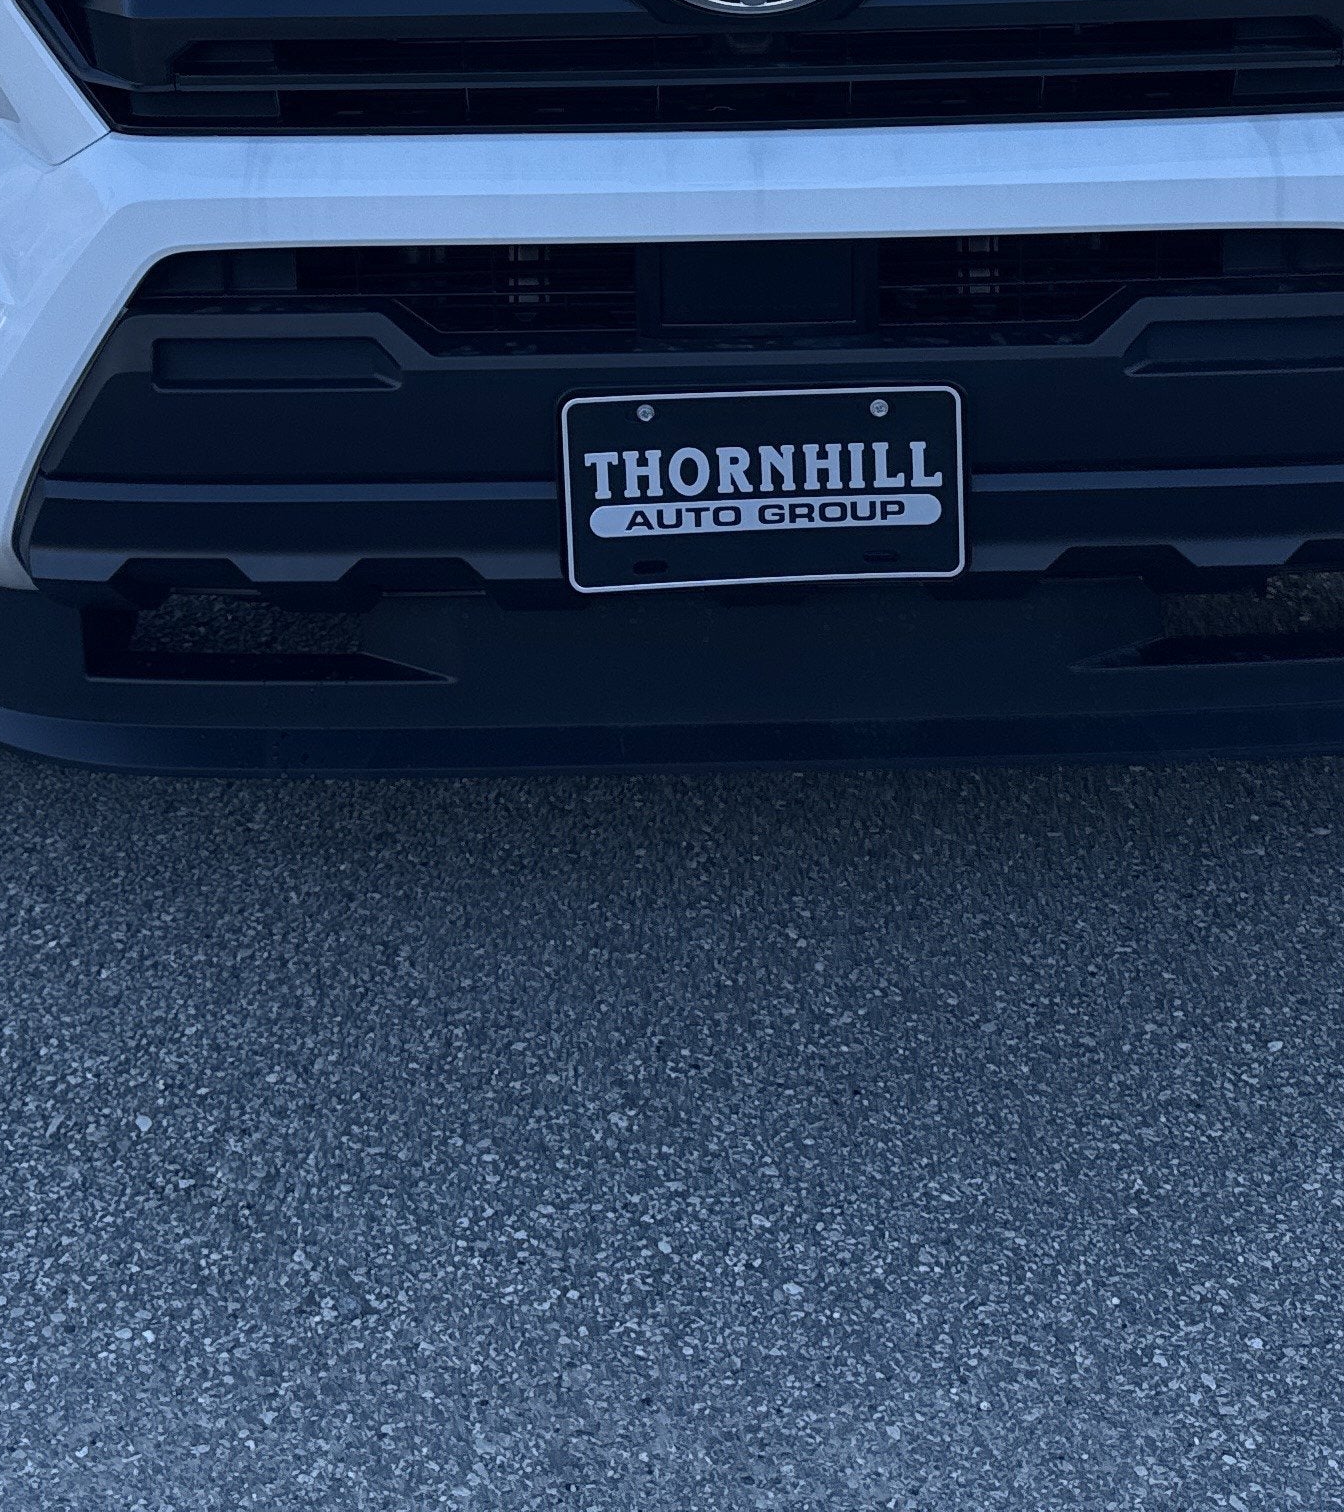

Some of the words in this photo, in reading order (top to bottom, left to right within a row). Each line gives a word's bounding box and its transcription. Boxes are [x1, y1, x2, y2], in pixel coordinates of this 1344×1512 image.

[584, 441, 943, 499] THORNHILL
[625, 506, 743, 531] AUTO
[758, 500, 906, 525] GROUP
